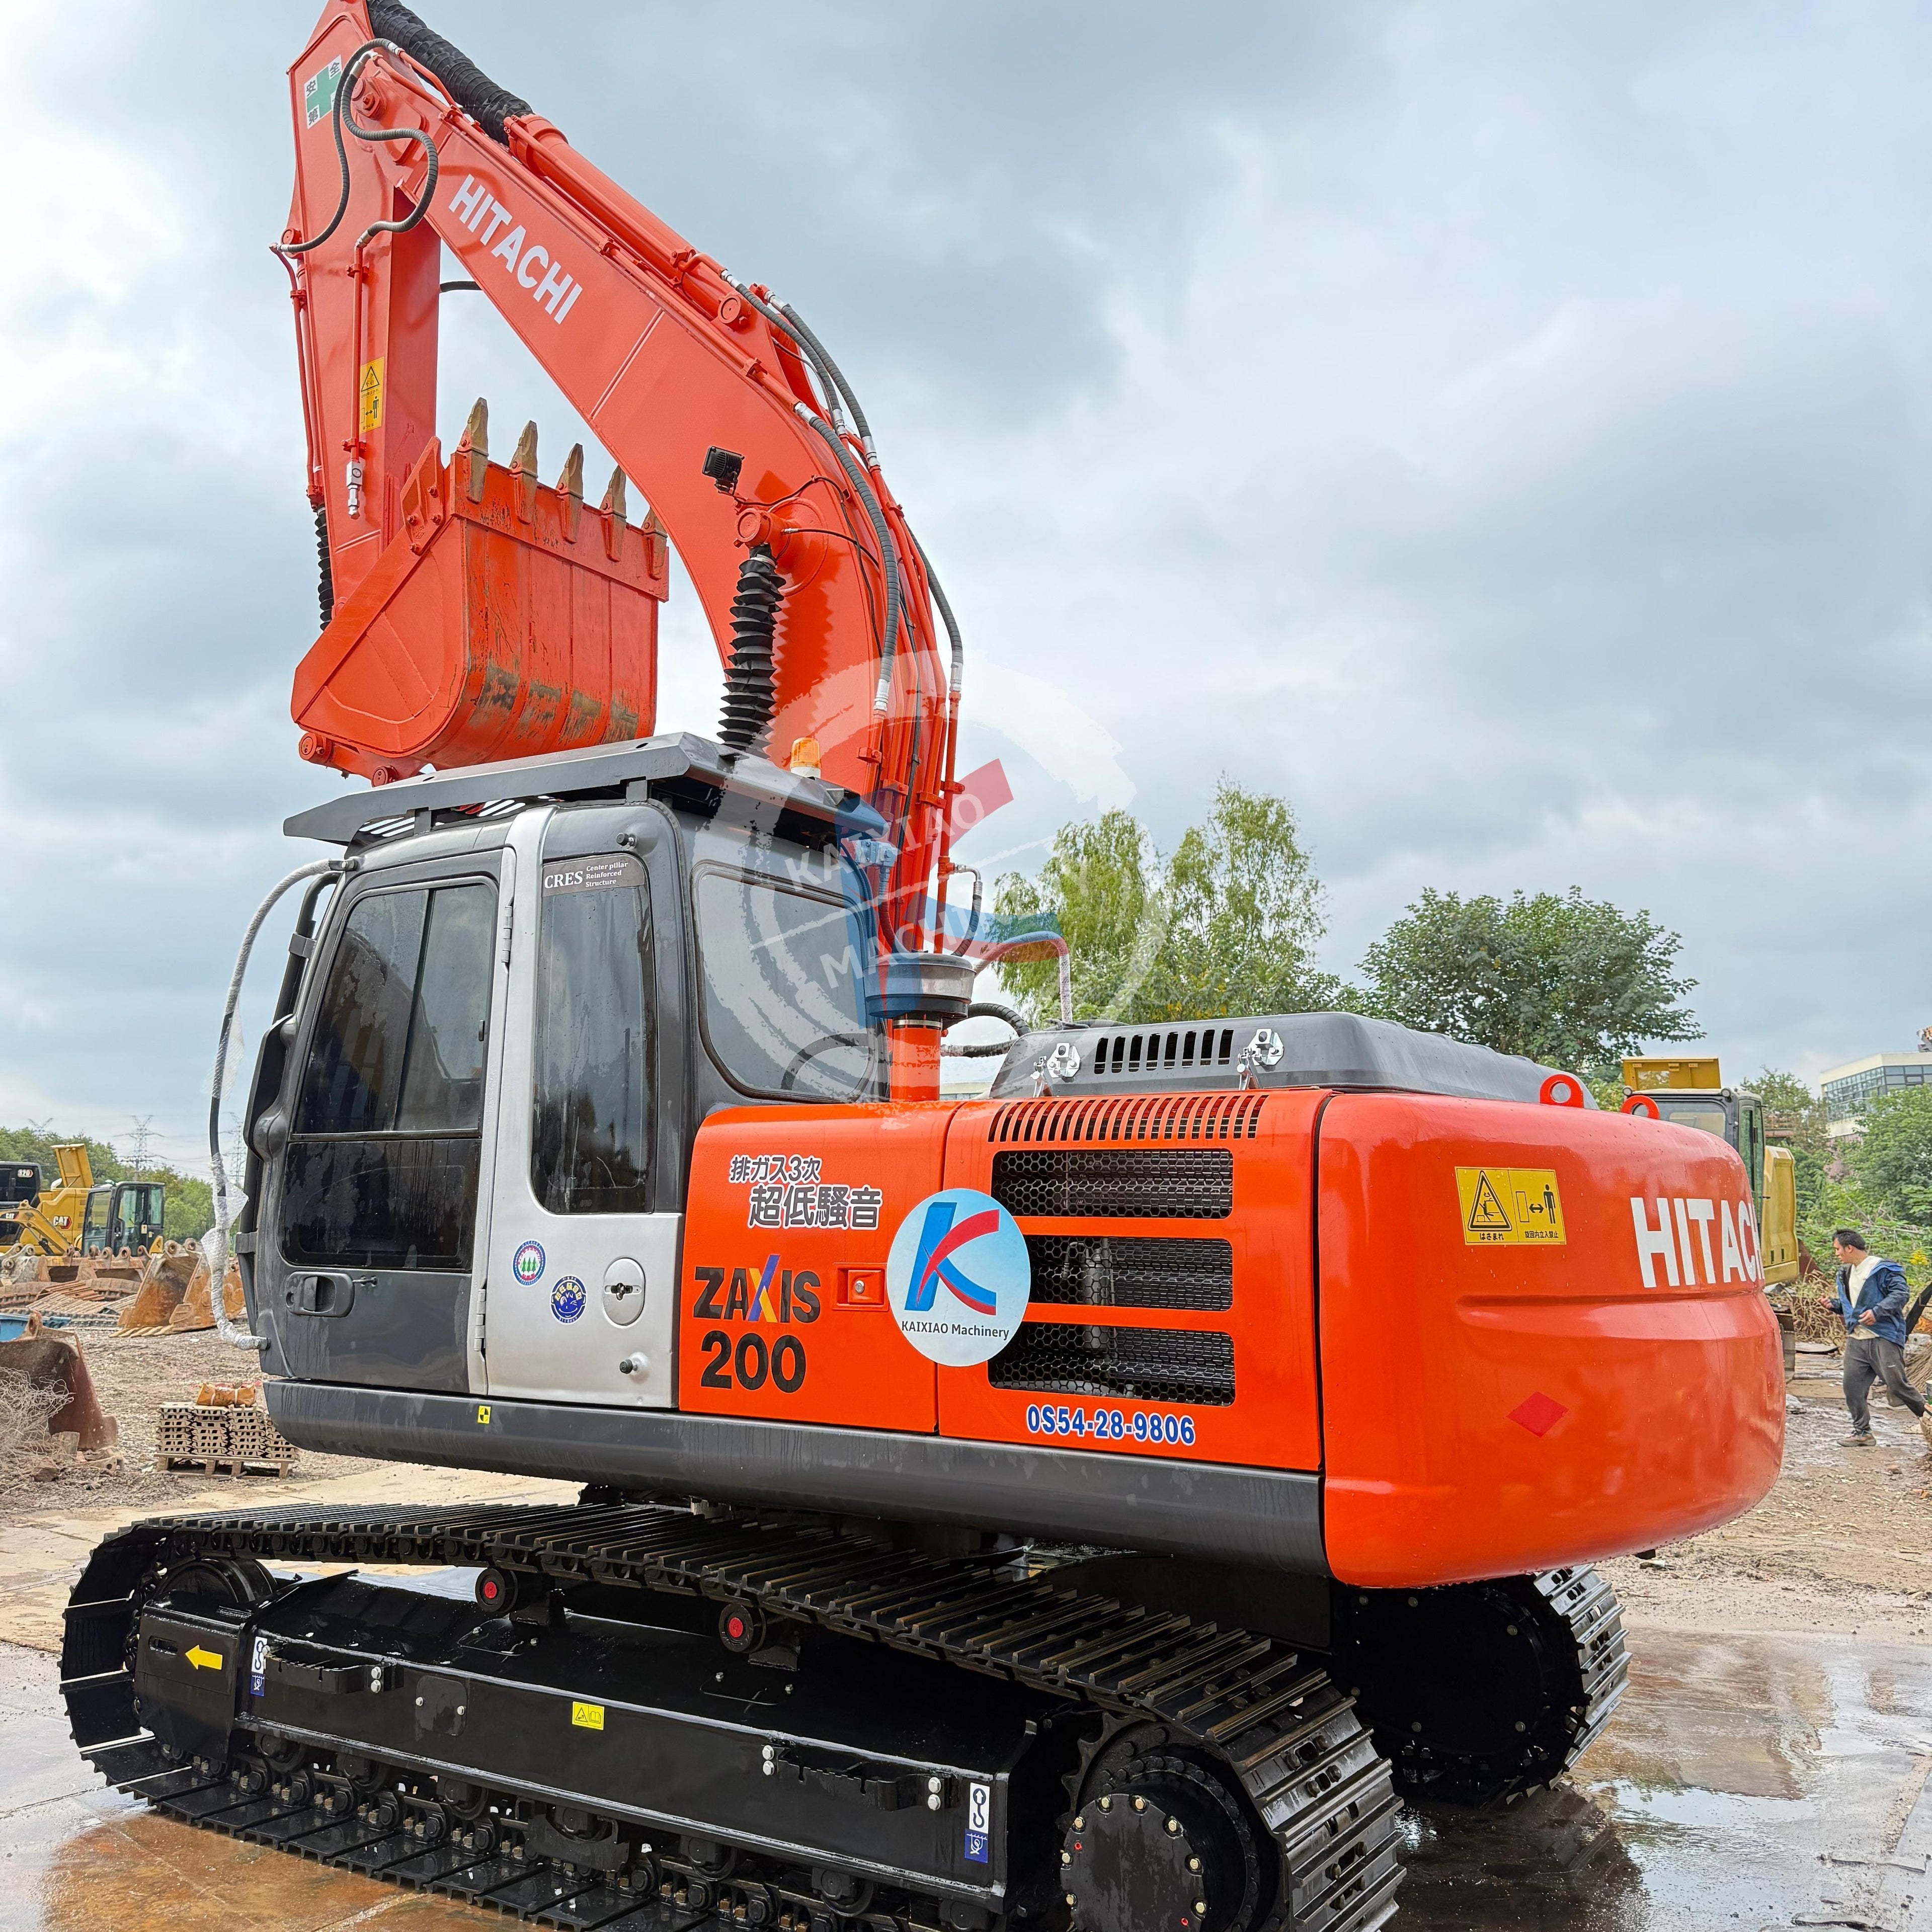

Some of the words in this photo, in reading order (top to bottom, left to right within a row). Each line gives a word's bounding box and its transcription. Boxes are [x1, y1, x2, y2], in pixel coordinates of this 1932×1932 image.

[448, 173, 583, 325] HITACHI
[586, 870, 622, 879] Reinforced
[609, 861, 628, 870] pillar
[544, 870, 584, 889] CRES
[586, 879, 616, 888] Structure
[729, 1155, 822, 1182] 排ガス3次
[749, 1184, 881, 1228] 超低騒音
[53, 1216, 69, 1227] CAT
[1479, 1232, 1504, 1241] はさまれ
[693, 1254, 821, 1323] ZAXIS
[902, 1321, 948, 1334] KAIXIAO
[952, 1324, 1009, 1341] Machinery
[701, 1330, 807, 1394] 200
